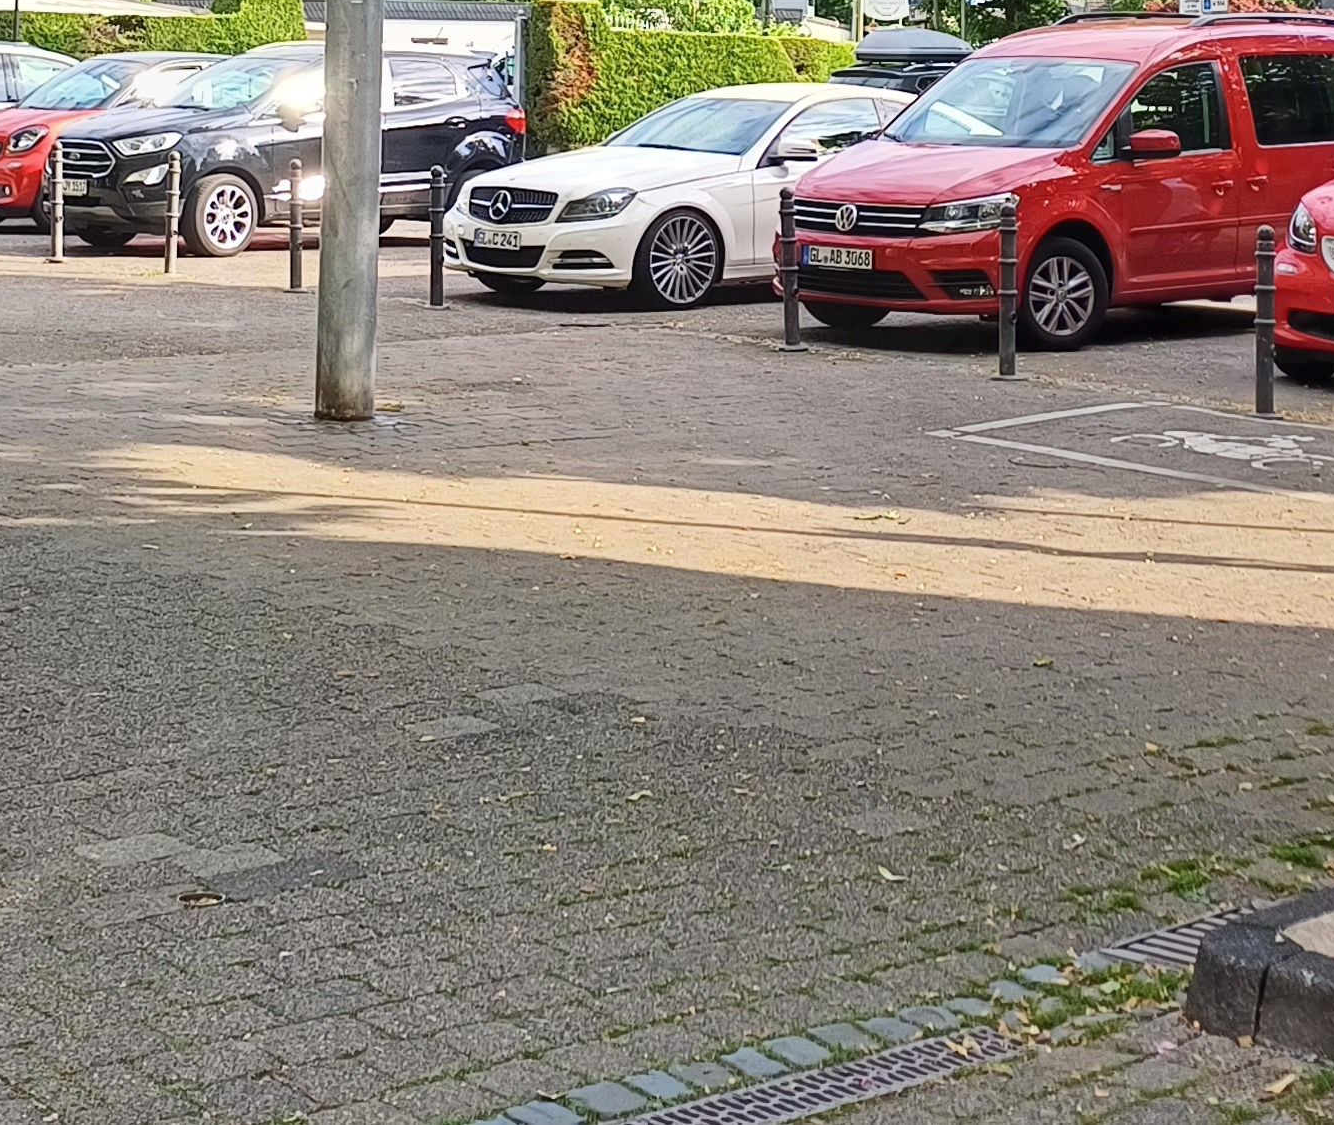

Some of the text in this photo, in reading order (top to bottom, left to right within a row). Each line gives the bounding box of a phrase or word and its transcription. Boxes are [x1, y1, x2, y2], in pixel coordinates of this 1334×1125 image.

[500, 233, 519, 248] 241
[810, 247, 871, 267] GL AB 3068
